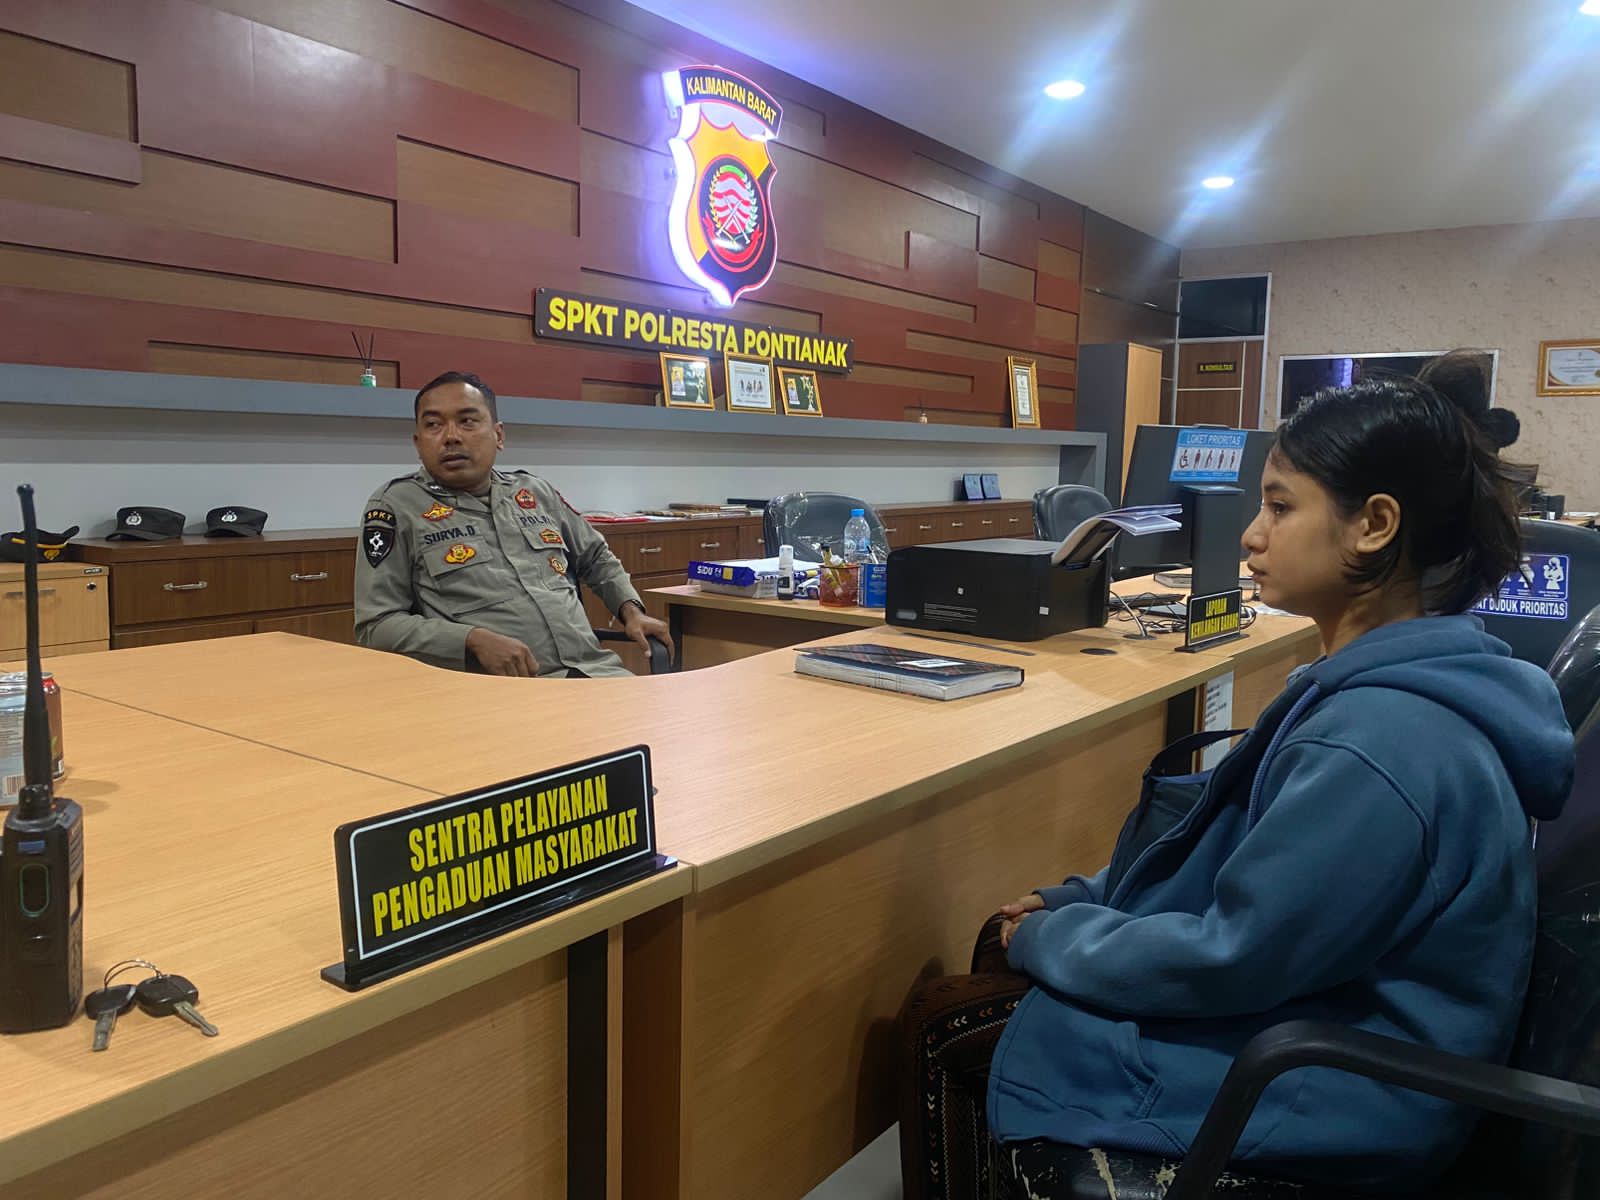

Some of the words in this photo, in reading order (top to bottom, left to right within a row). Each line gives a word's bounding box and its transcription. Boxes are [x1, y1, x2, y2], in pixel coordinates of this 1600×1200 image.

[686, 77, 746, 104] KALIMANTAN
[747, 91, 777, 125] BARAT
[548, 297, 619, 337] SPKT
[624, 308, 739, 353] POLRESTA
[744, 328, 849, 368] PONTIANAK
[367, 511, 392, 521] SPKT
[424, 525, 476, 545] SURYA.D
[1520, 600, 1565, 616] PRIORITAS
[409, 807, 498, 872] SENTRA
[502, 774, 609, 841] PELAYANAN
[372, 851, 511, 937] PENGADUAN
[515, 807, 638, 886] MASYARAKAT
